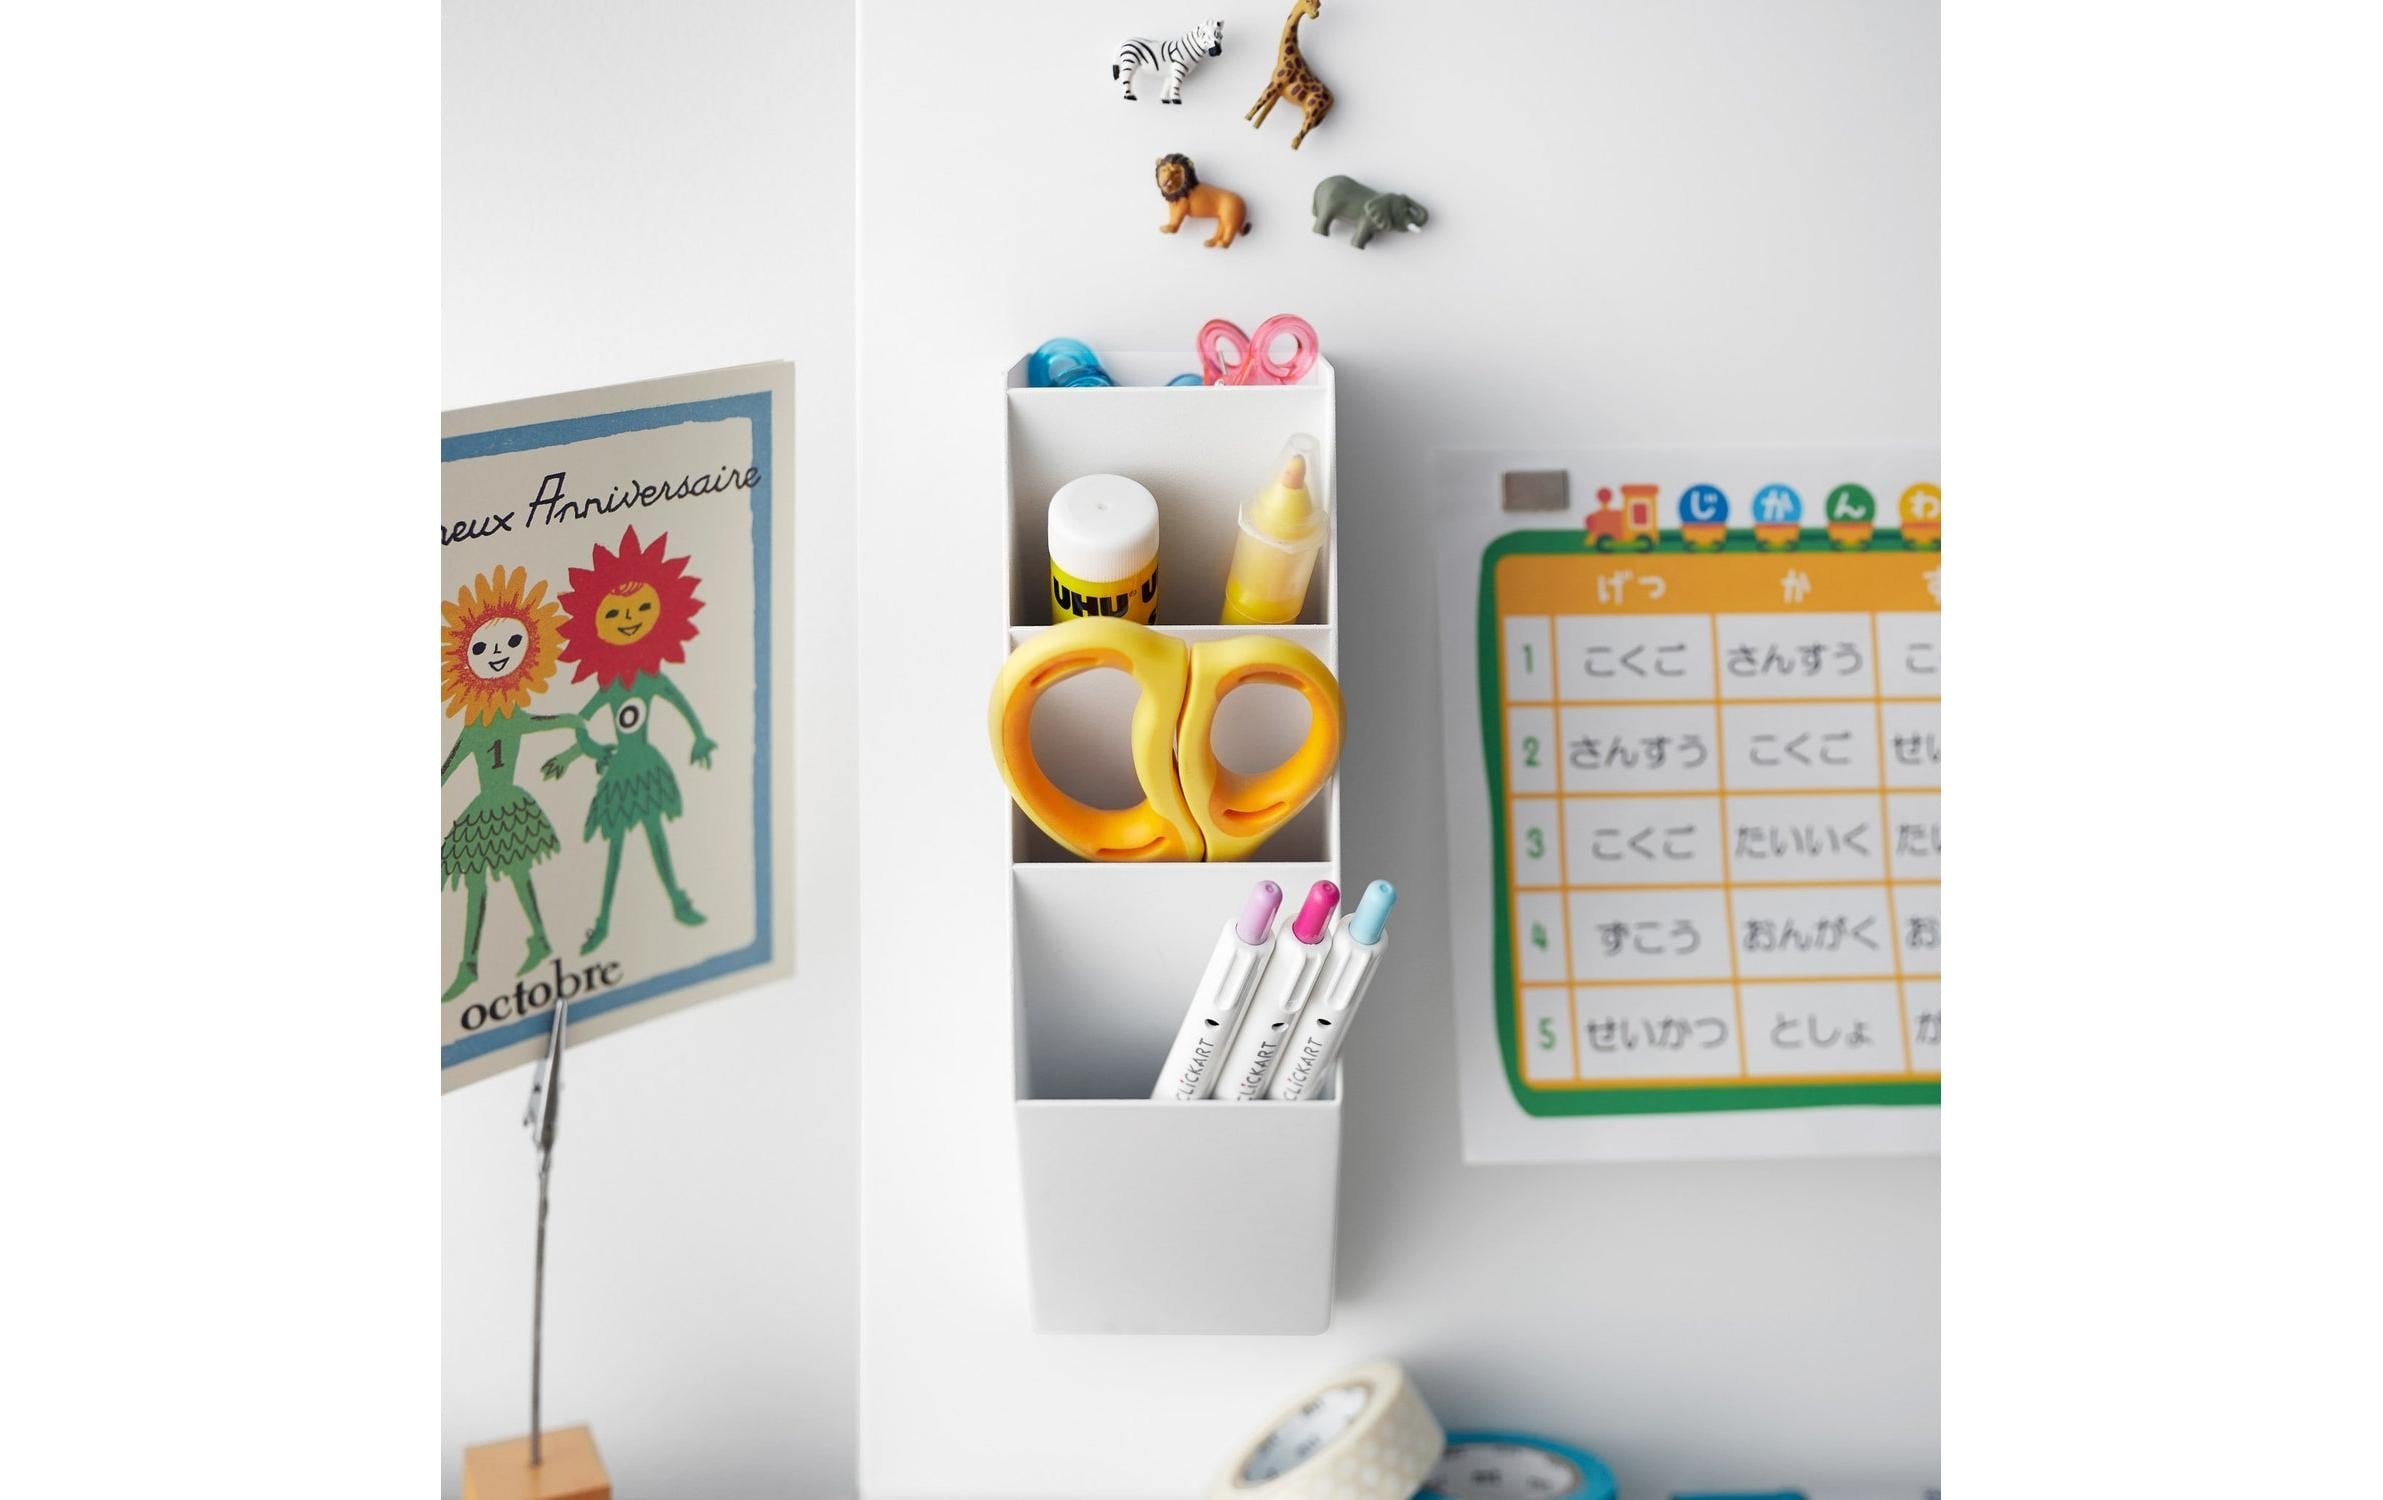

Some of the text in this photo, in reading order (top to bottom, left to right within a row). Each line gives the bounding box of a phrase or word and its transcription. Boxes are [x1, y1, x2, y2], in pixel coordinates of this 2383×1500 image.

[525, 465, 761, 528] Anniversaire
[1053, 575, 1129, 618] UHU
[1597, 570, 1666, 605] げつ
[1780, 569, 1812, 604] か
[1522, 643, 1534, 673] 1
[1584, 643, 1687, 678] こくご
[1727, 641, 1863, 677] さんすう
[1906, 642, 1938, 674] こ
[487, 739, 504, 770] 1
[1522, 735, 1540, 768] 2
[1569, 733, 1708, 770] さんすう
[1750, 732, 1852, 768] こくご
[1526, 826, 1546, 859] 3
[1591, 825, 1697, 861] こくご
[1734, 823, 1872, 859] たいいく
[1531, 921, 1549, 952] 4
[1742, 915, 1880, 952] おんがく
[460, 958, 623, 1031] octobre
[1538, 1017, 1556, 1050] 5
[1586, 1016, 1729, 1053] せいかつ
[1770, 1011, 1873, 1049] としょ
